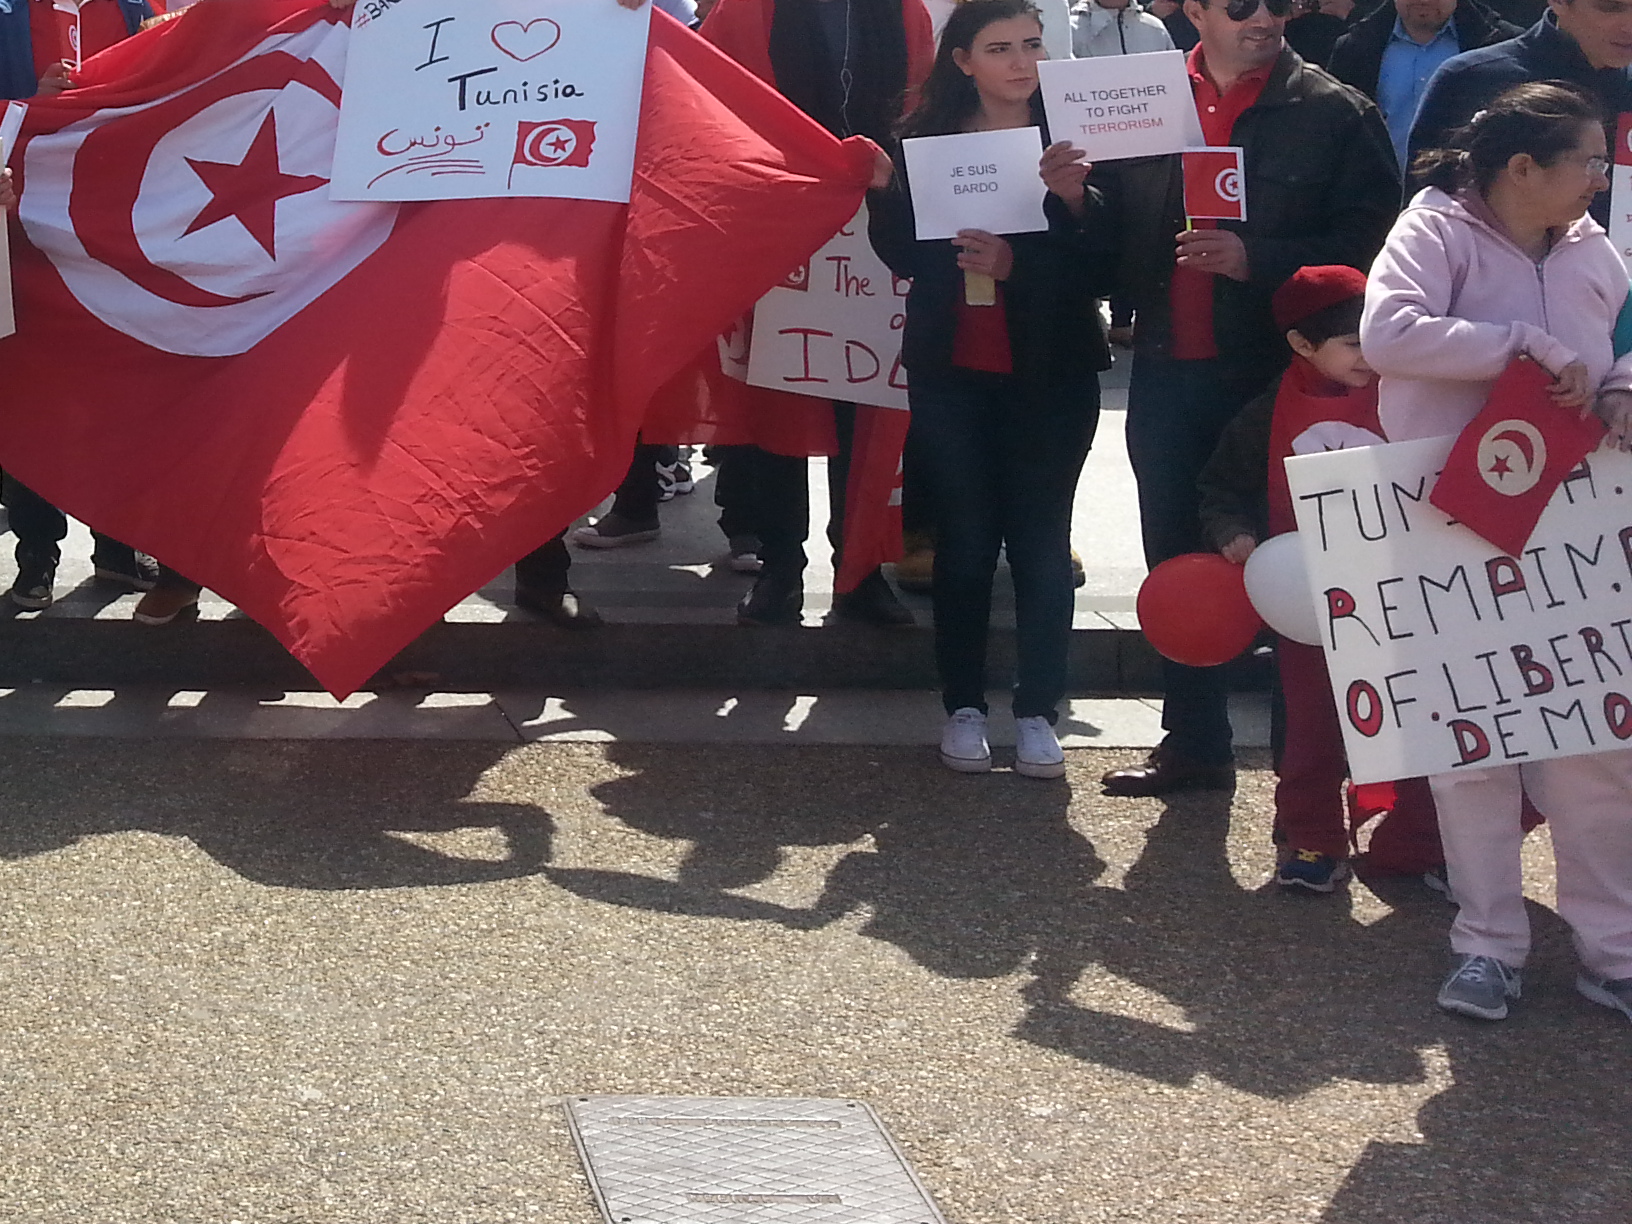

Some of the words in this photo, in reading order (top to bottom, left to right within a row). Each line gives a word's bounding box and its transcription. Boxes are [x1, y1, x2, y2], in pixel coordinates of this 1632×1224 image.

[415, 17, 455, 72] I
[448, 67, 584, 111] Tunisia
[1064, 92, 1087, 103] ALL
[1090, 84, 1167, 101] TOGETHER
[1086, 107, 1104, 118] TO
[1108, 102, 1149, 116] FIGHT
[1079, 117, 1164, 135] TERRORISM
[376, 122, 491, 161] تونس
[950, 166, 965, 178] JE
[968, 163, 997, 176] SUIS
[953, 181, 998, 195] BARDO
[826, 256, 875, 297] The
